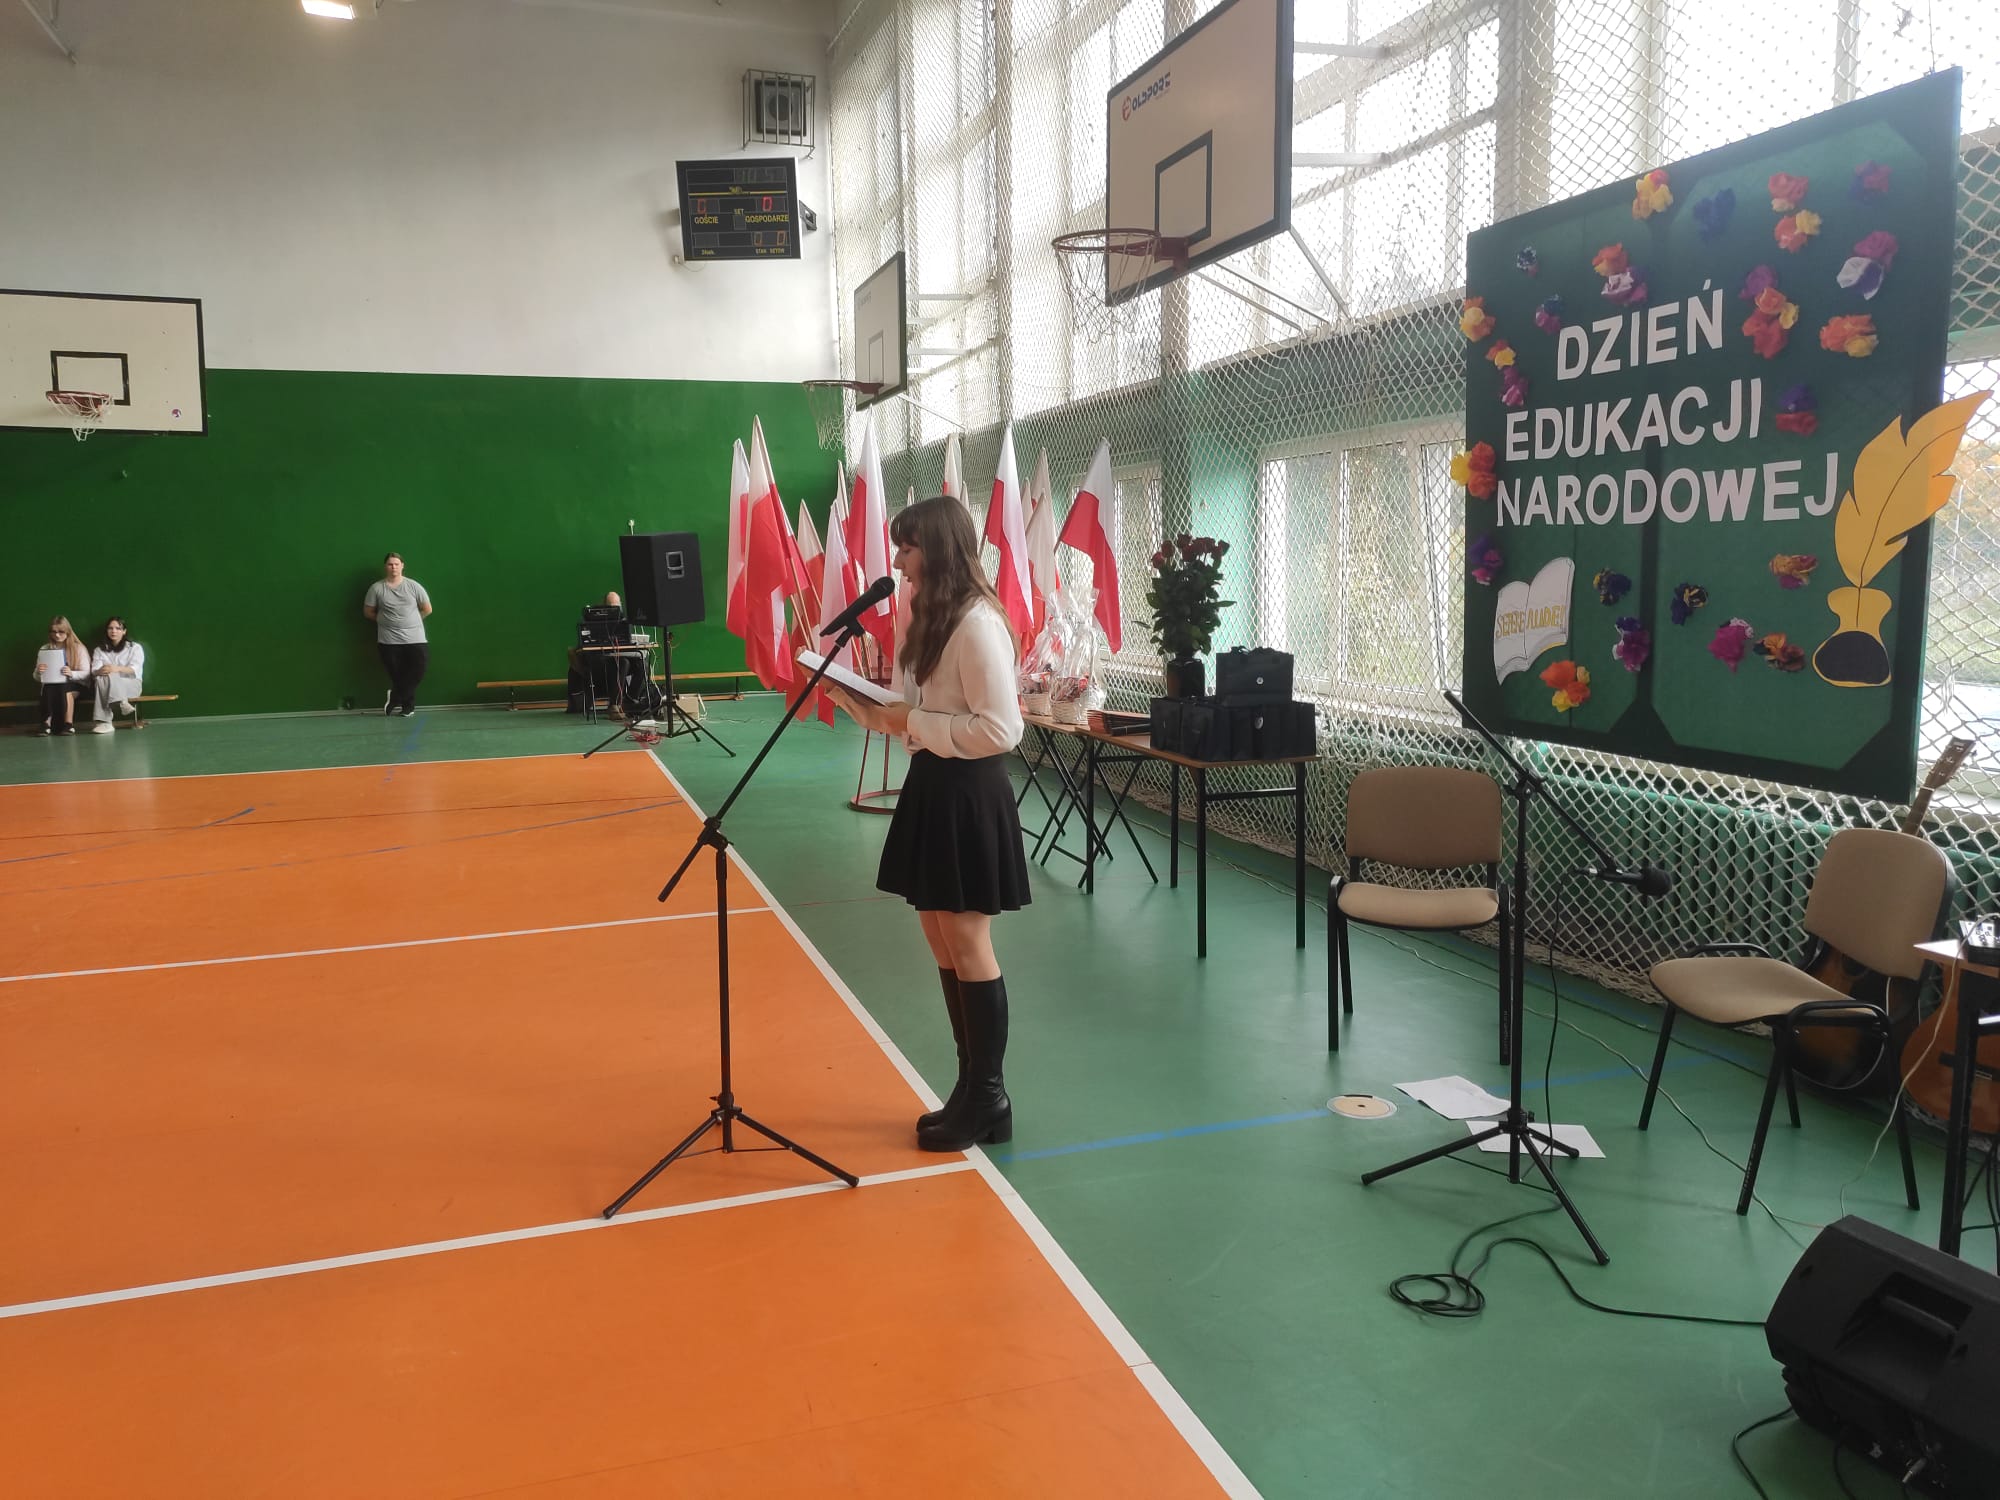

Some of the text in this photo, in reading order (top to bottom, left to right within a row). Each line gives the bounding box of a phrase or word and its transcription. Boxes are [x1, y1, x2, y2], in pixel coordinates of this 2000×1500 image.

[694, 214, 719, 225] GOŚCIE
[745, 214, 789, 224] GOSPODARZE
[1557, 279, 1723, 380] DZIEŃ
[1505, 378, 1762, 461] EDUKACJI
[1497, 453, 1838, 527] NARODOWEJ
